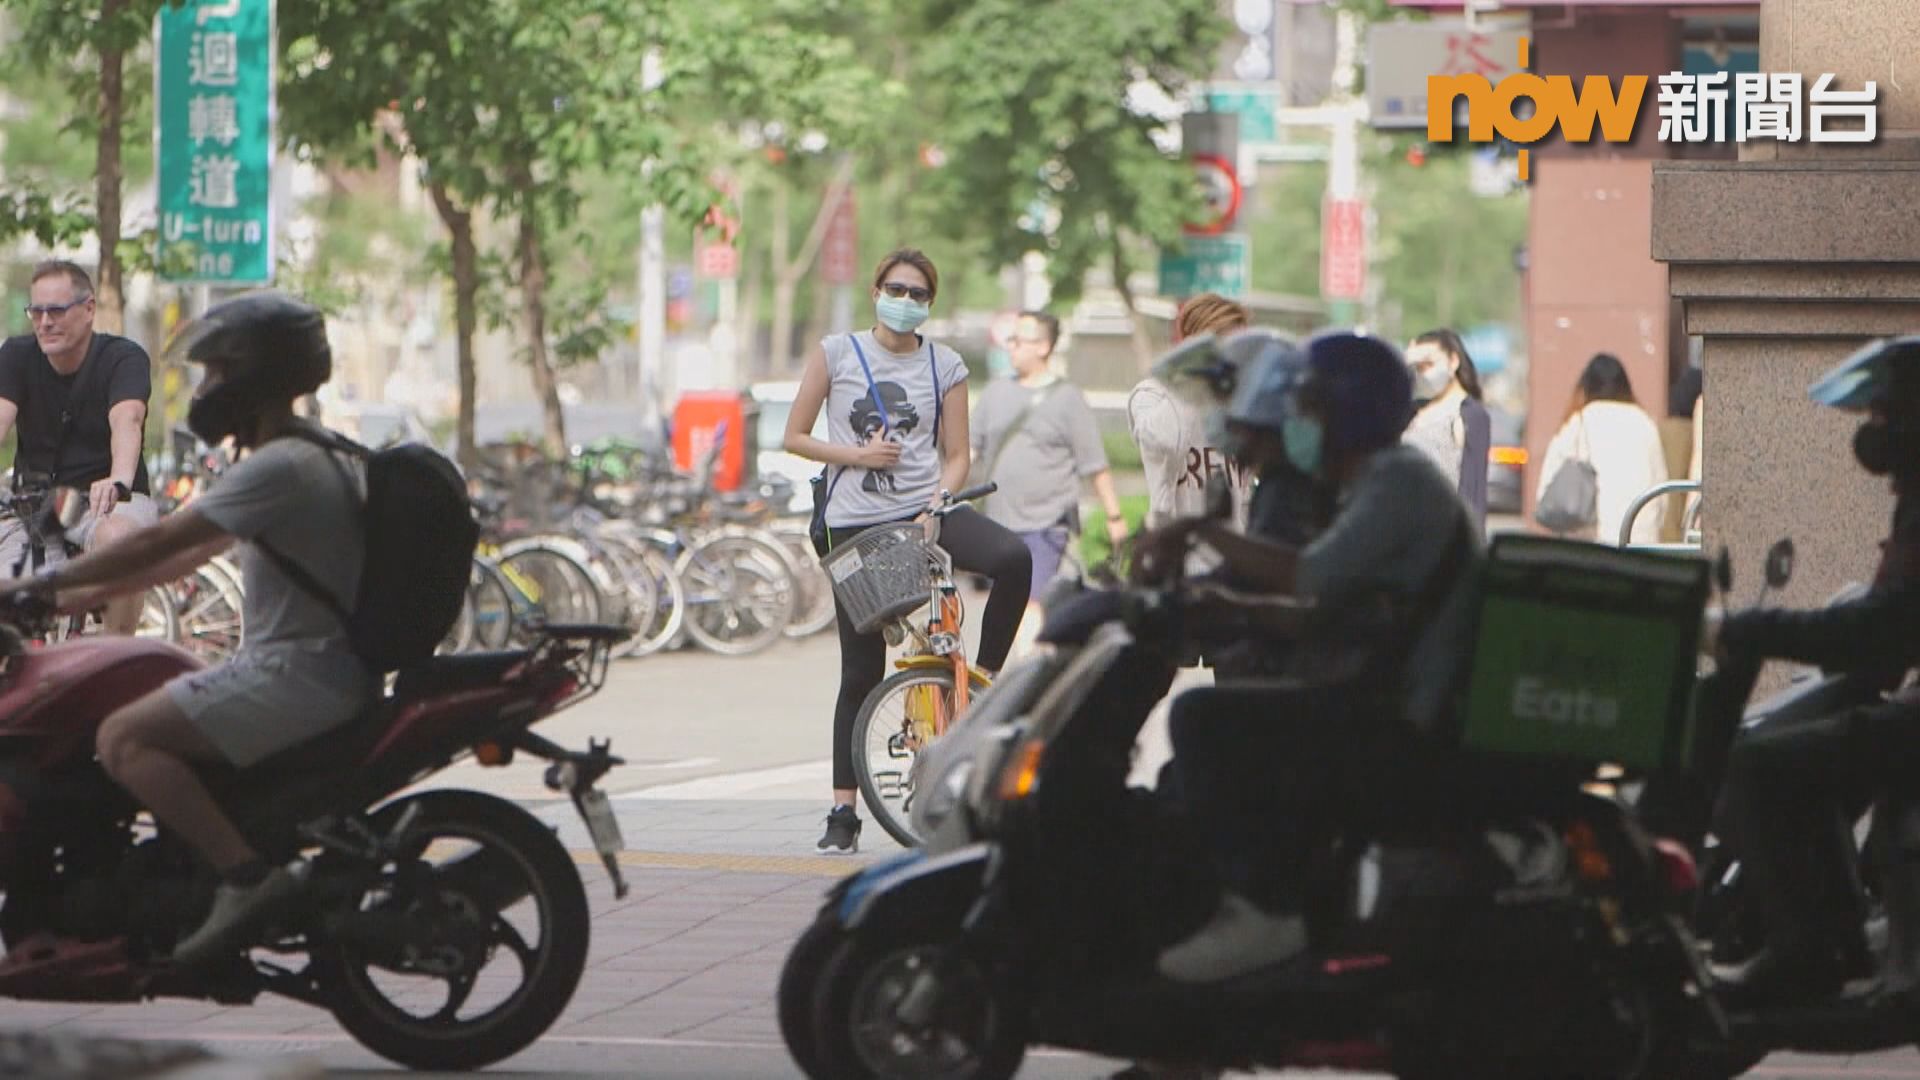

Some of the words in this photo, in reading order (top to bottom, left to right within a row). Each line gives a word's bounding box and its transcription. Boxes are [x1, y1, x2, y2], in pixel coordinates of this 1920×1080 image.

[188, 31, 241, 208] 迴轉道
[164, 211, 261, 244] U-turn
